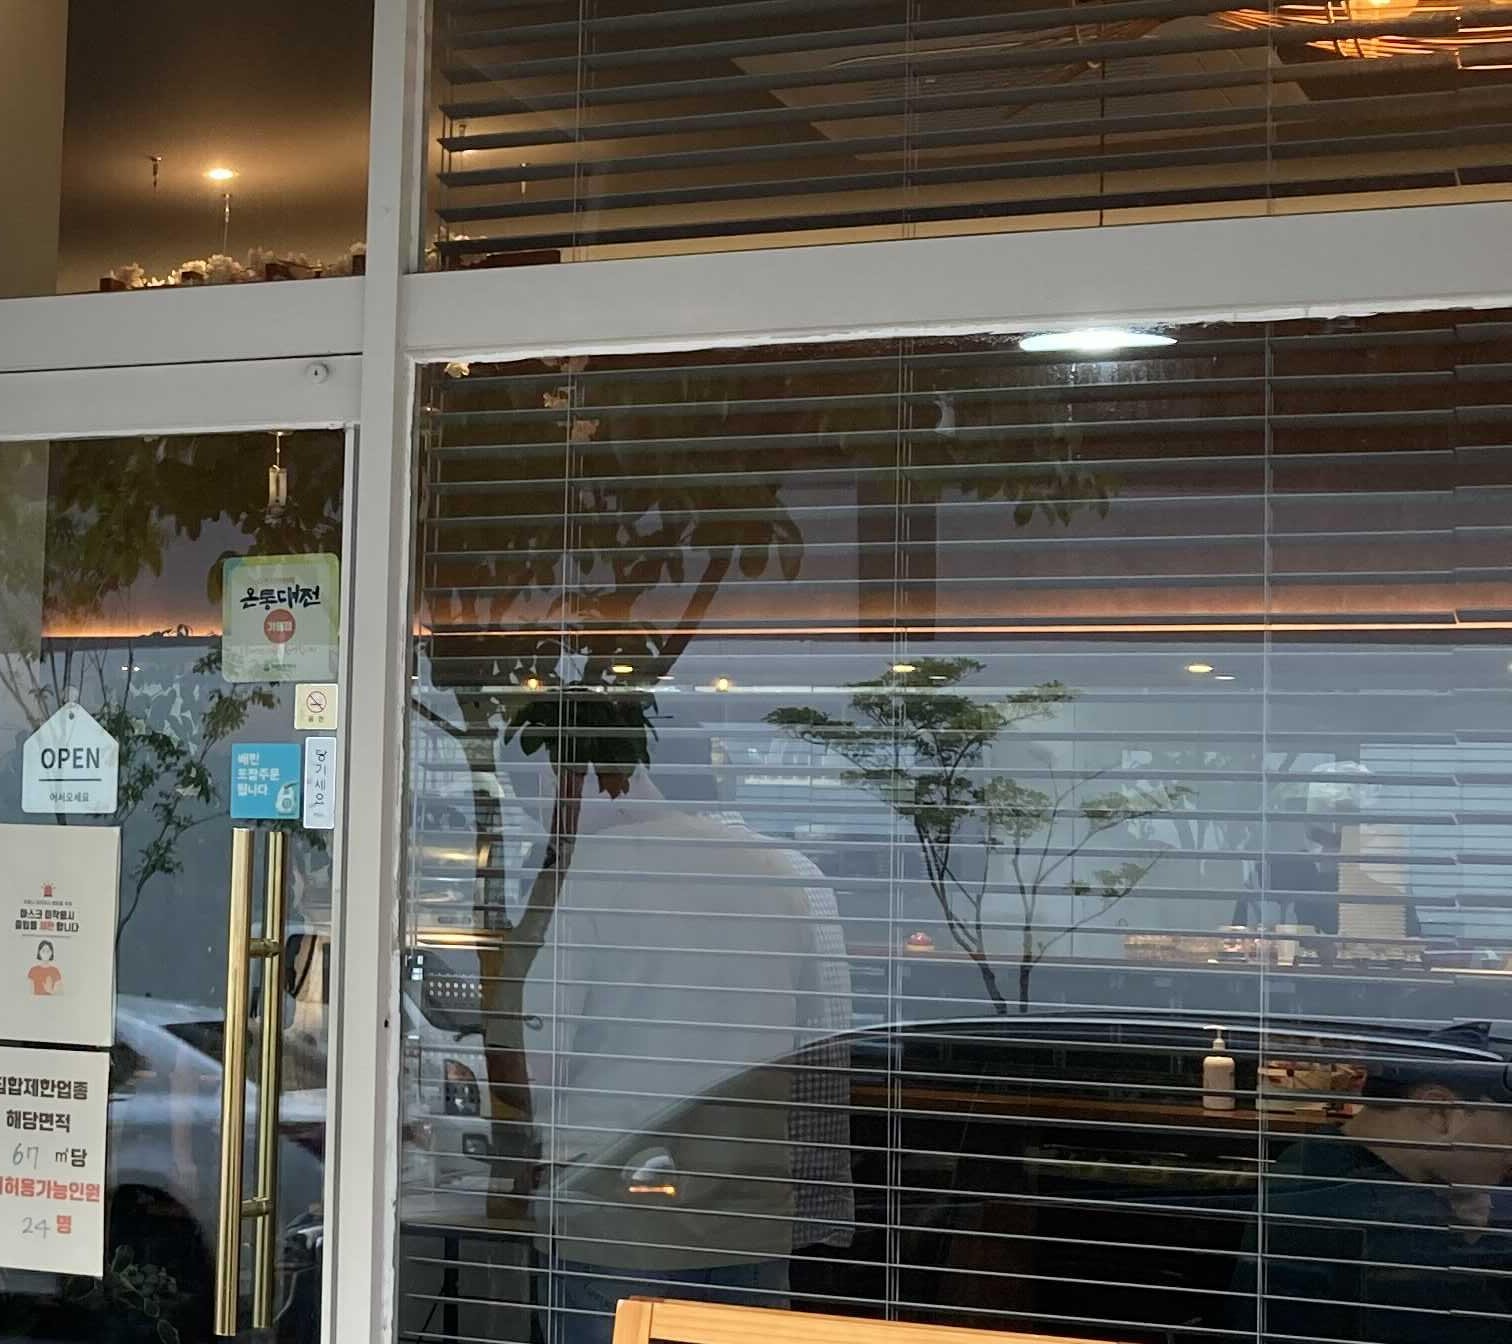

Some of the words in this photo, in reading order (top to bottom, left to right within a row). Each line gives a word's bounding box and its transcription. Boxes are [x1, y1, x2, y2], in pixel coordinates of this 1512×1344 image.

[240, 584, 321, 610] 온통대전
[41, 747, 100, 769] OPEN
[313, 749, 328, 806] 당기세요
[49, 791, 90, 802] 어서오세요
[6, 1109, 71, 1134] 해당면적
[12, 1142, 39, 1170] 67
[22, 1216, 50, 1240] 24
[56, 1214, 72, 1234] 명
